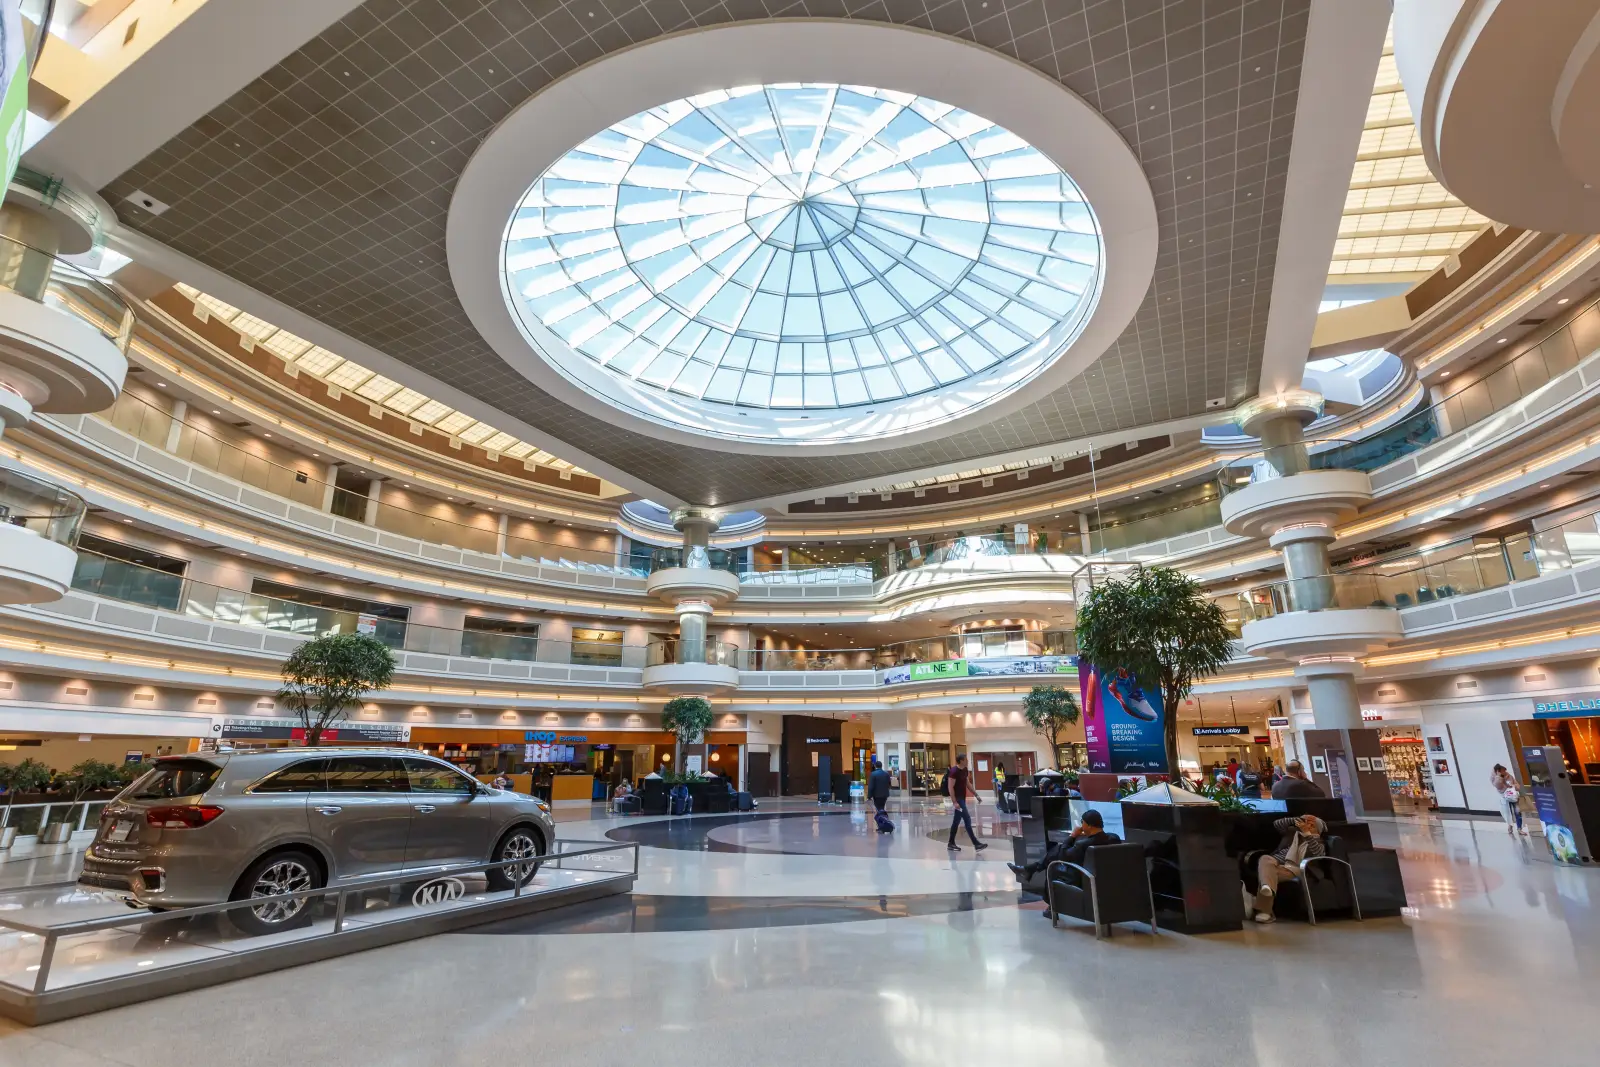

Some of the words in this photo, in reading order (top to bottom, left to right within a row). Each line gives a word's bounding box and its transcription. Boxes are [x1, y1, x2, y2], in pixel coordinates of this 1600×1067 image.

[1354, 551, 1375, 561] Guest
[228, 719, 298, 727] DOMESTIC
[1200, 727, 1222, 735] Arrivals
[1222, 727, 1241, 735] Lobby
[421, 882, 456, 906] KIA
